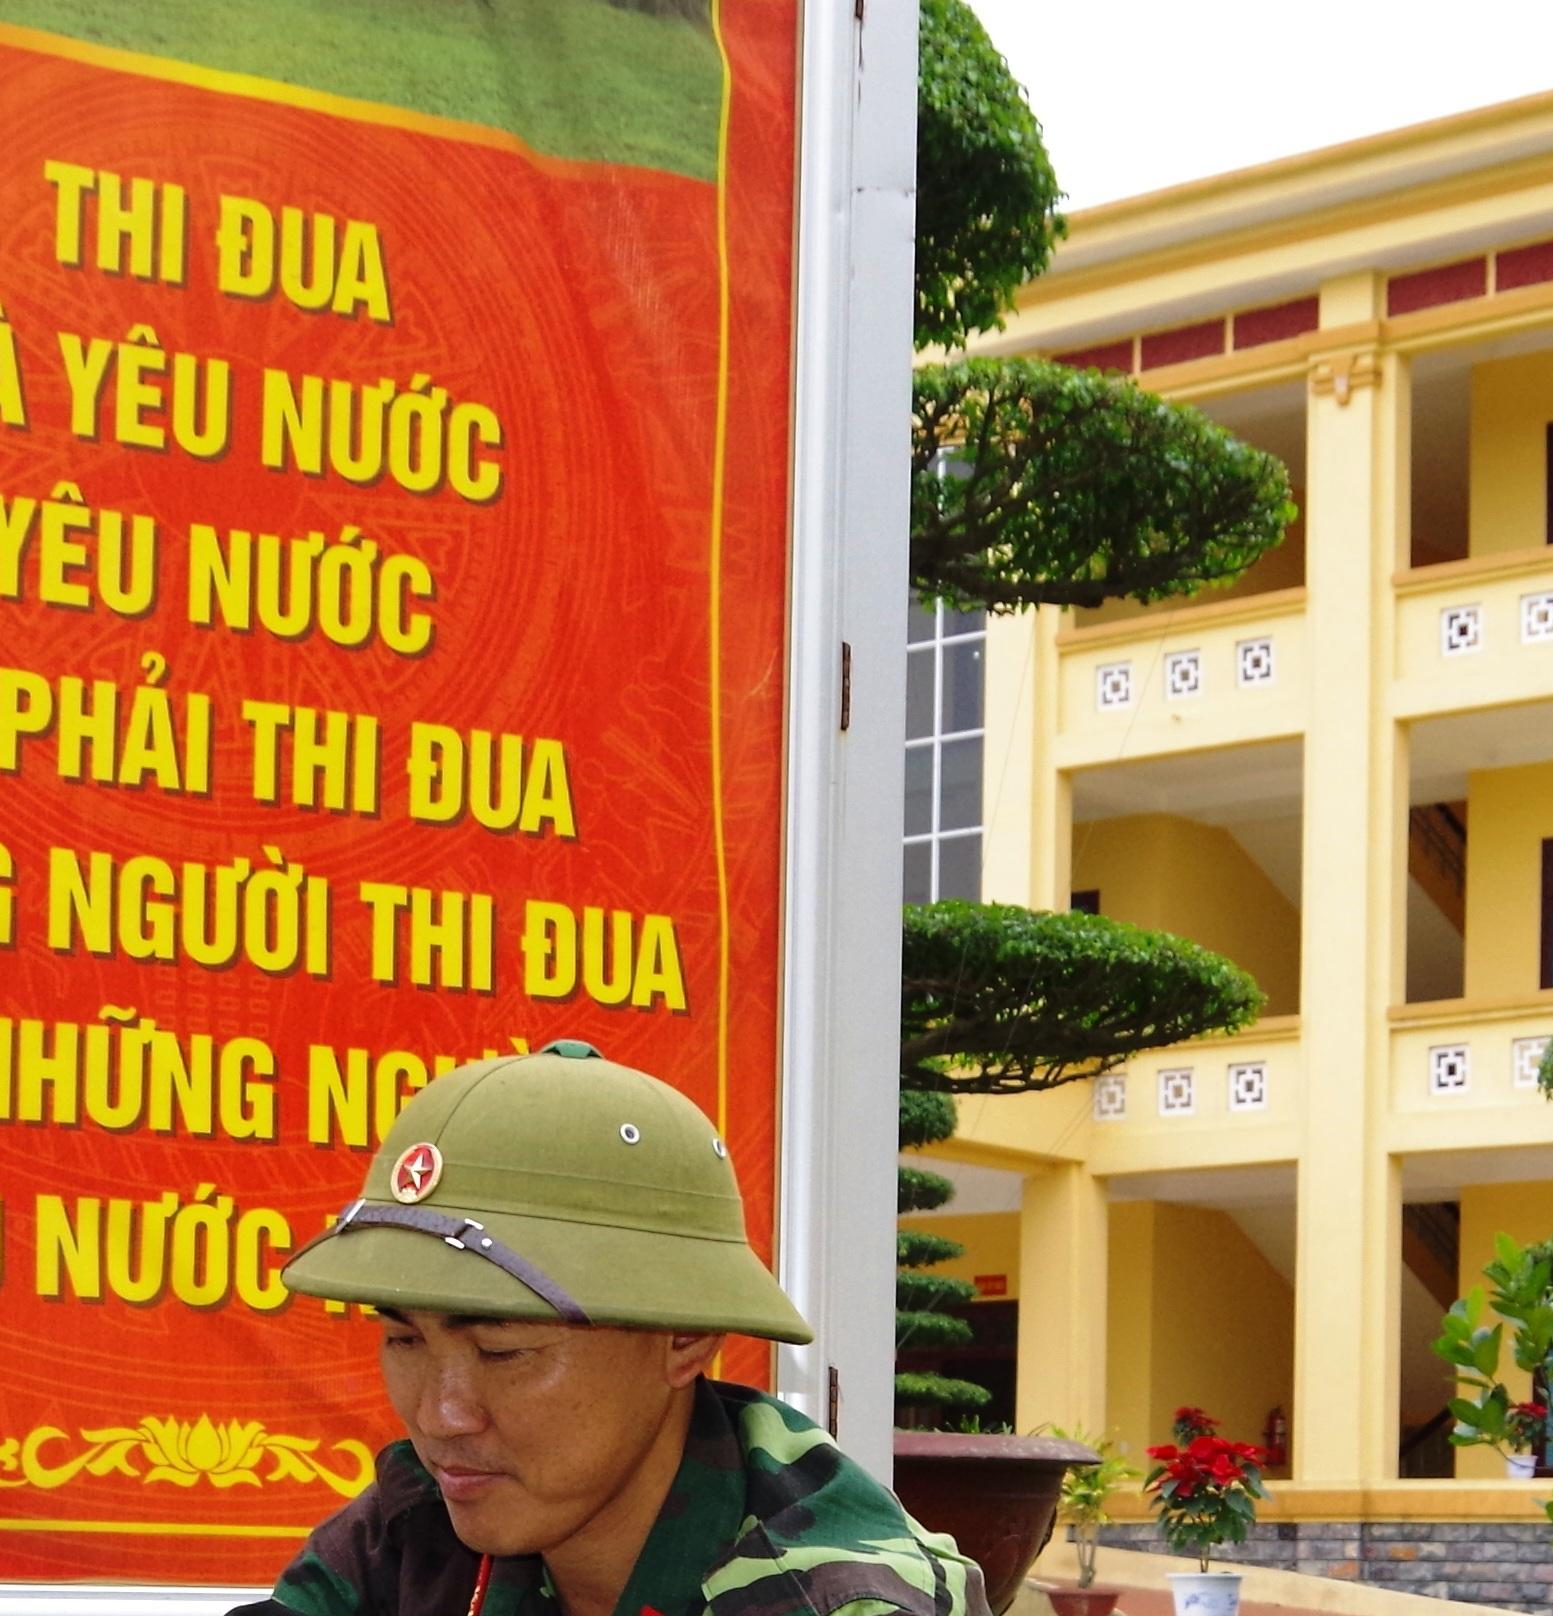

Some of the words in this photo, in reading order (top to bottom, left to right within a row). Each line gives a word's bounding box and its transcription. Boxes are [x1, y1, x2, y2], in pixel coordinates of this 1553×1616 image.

[45, 162, 186, 284] THI
[216, 197, 391, 322] ĐUA
[60, 325, 230, 458] YÊU
[263, 370, 501, 501] NƯỚC
[190, 525, 433, 655] NƯỚC
[243, 702, 378, 815] THI
[407, 723, 576, 839] ĐUA
[50, 847, 328, 977] NGƯỜI
[360, 883, 495, 993] THI
[521, 902, 687, 1011] ĐUA
[37, 1186, 291, 1311] NƯỚC
